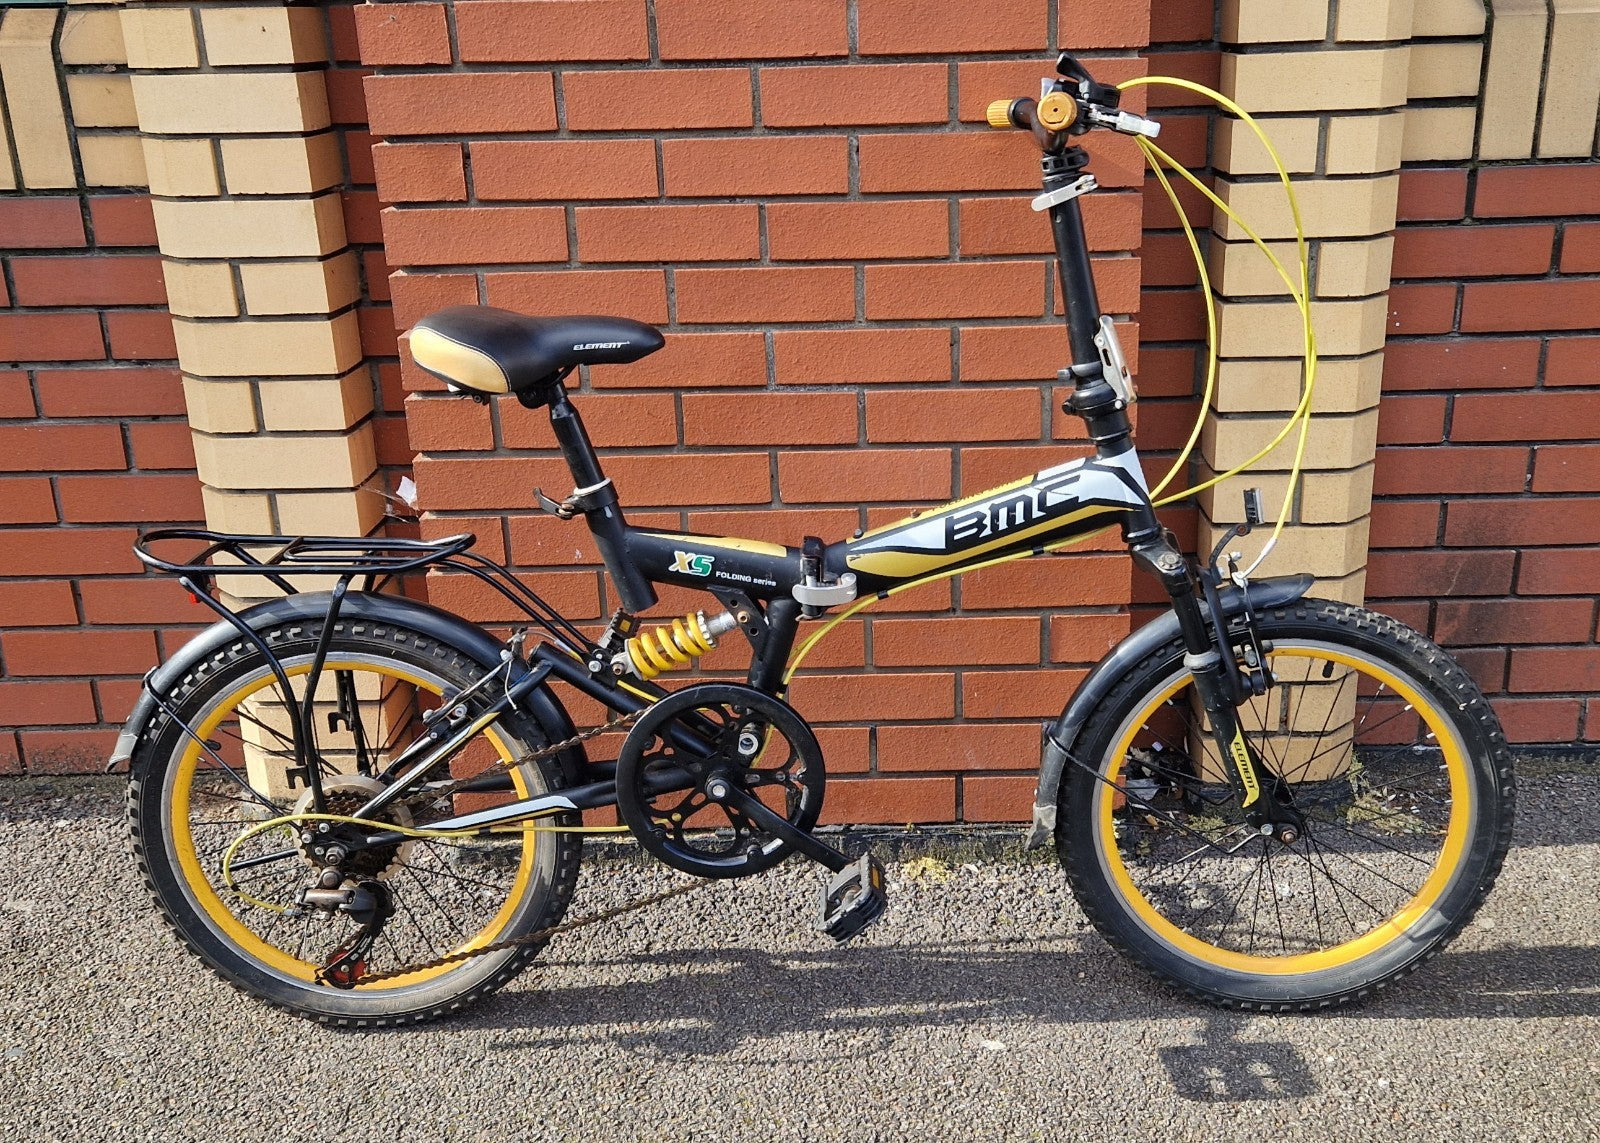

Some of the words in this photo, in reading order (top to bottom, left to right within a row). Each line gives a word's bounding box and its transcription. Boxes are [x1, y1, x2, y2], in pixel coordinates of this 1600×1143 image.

[573, 342, 630, 351] ELEMENT
[945, 474, 1081, 548] BMC
[668, 550, 715, 577] XS
[715, 571, 752, 583] FOLDING
[753, 578, 777, 587] series
[1234, 742, 1256, 788] ELEMENT
